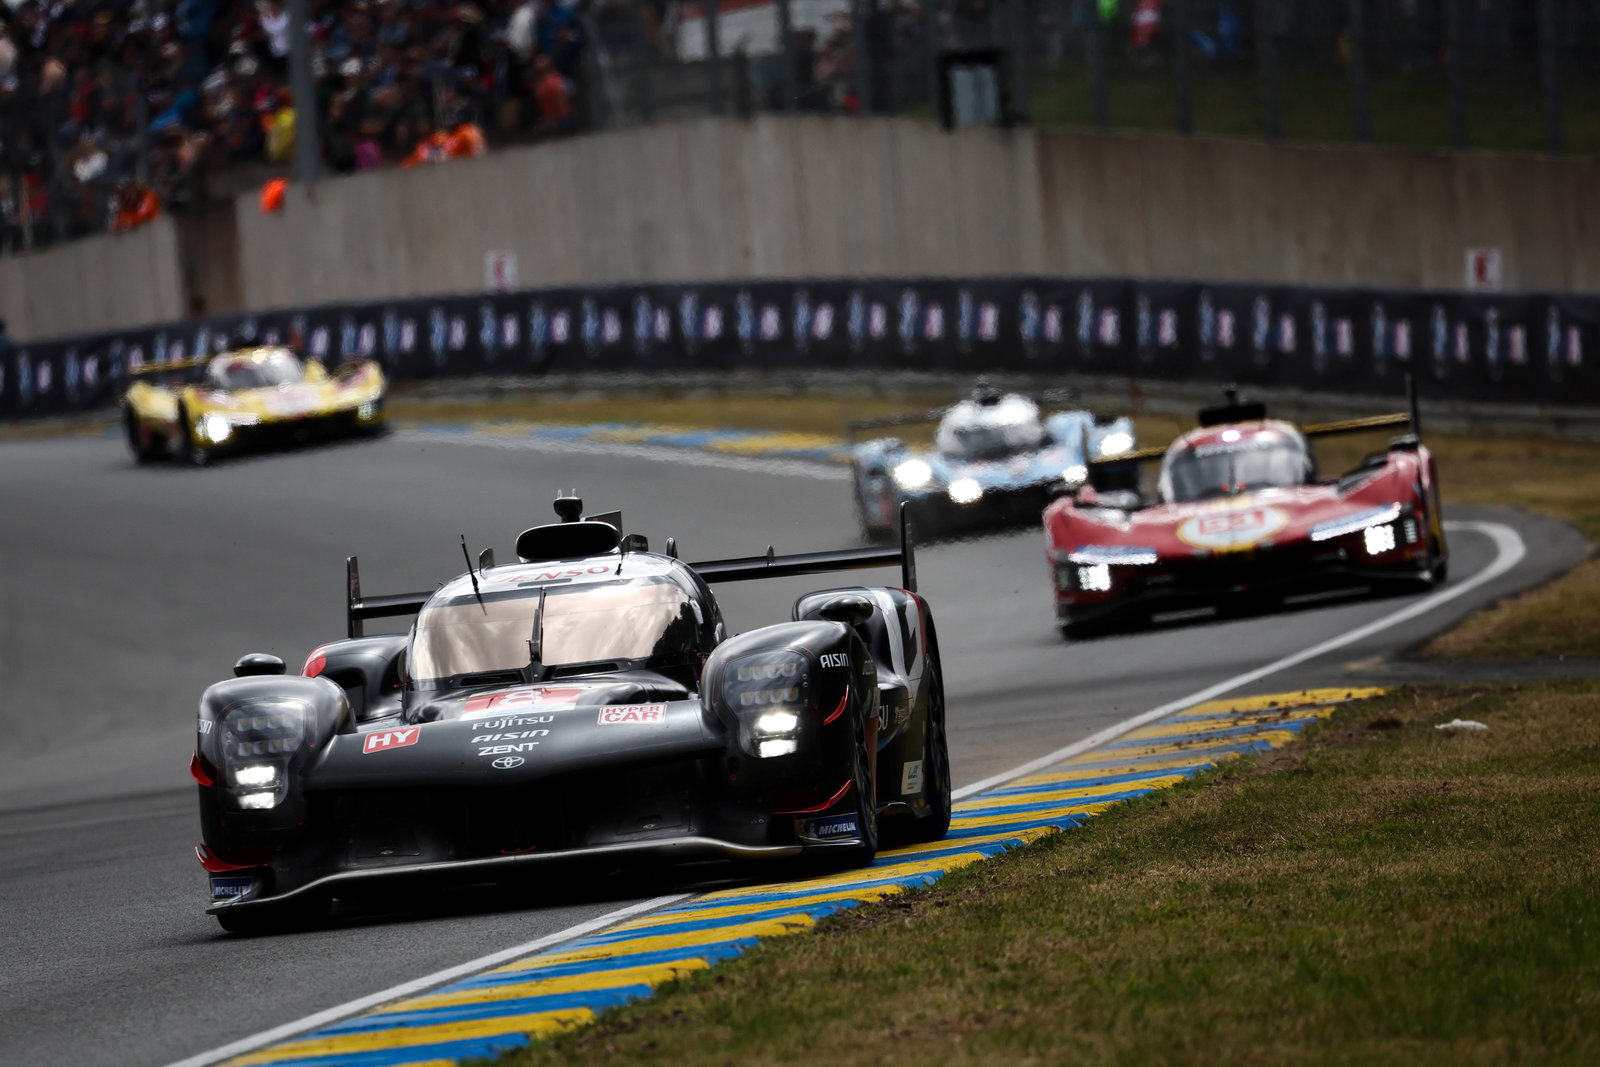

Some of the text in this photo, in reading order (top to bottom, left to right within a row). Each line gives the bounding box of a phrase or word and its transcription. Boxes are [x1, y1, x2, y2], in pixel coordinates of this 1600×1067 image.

[820, 653, 849, 668] AISIN
[500, 691, 544, 706] 8
[605, 701, 660, 713] HYPER
[471, 715, 555, 731] FUJITSU
[604, 712, 659, 722] CAR
[367, 729, 416, 749] HY
[471, 729, 550, 743] AISIN
[478, 741, 540, 756] ZENT
[818, 822, 856, 835] MICHELIN
